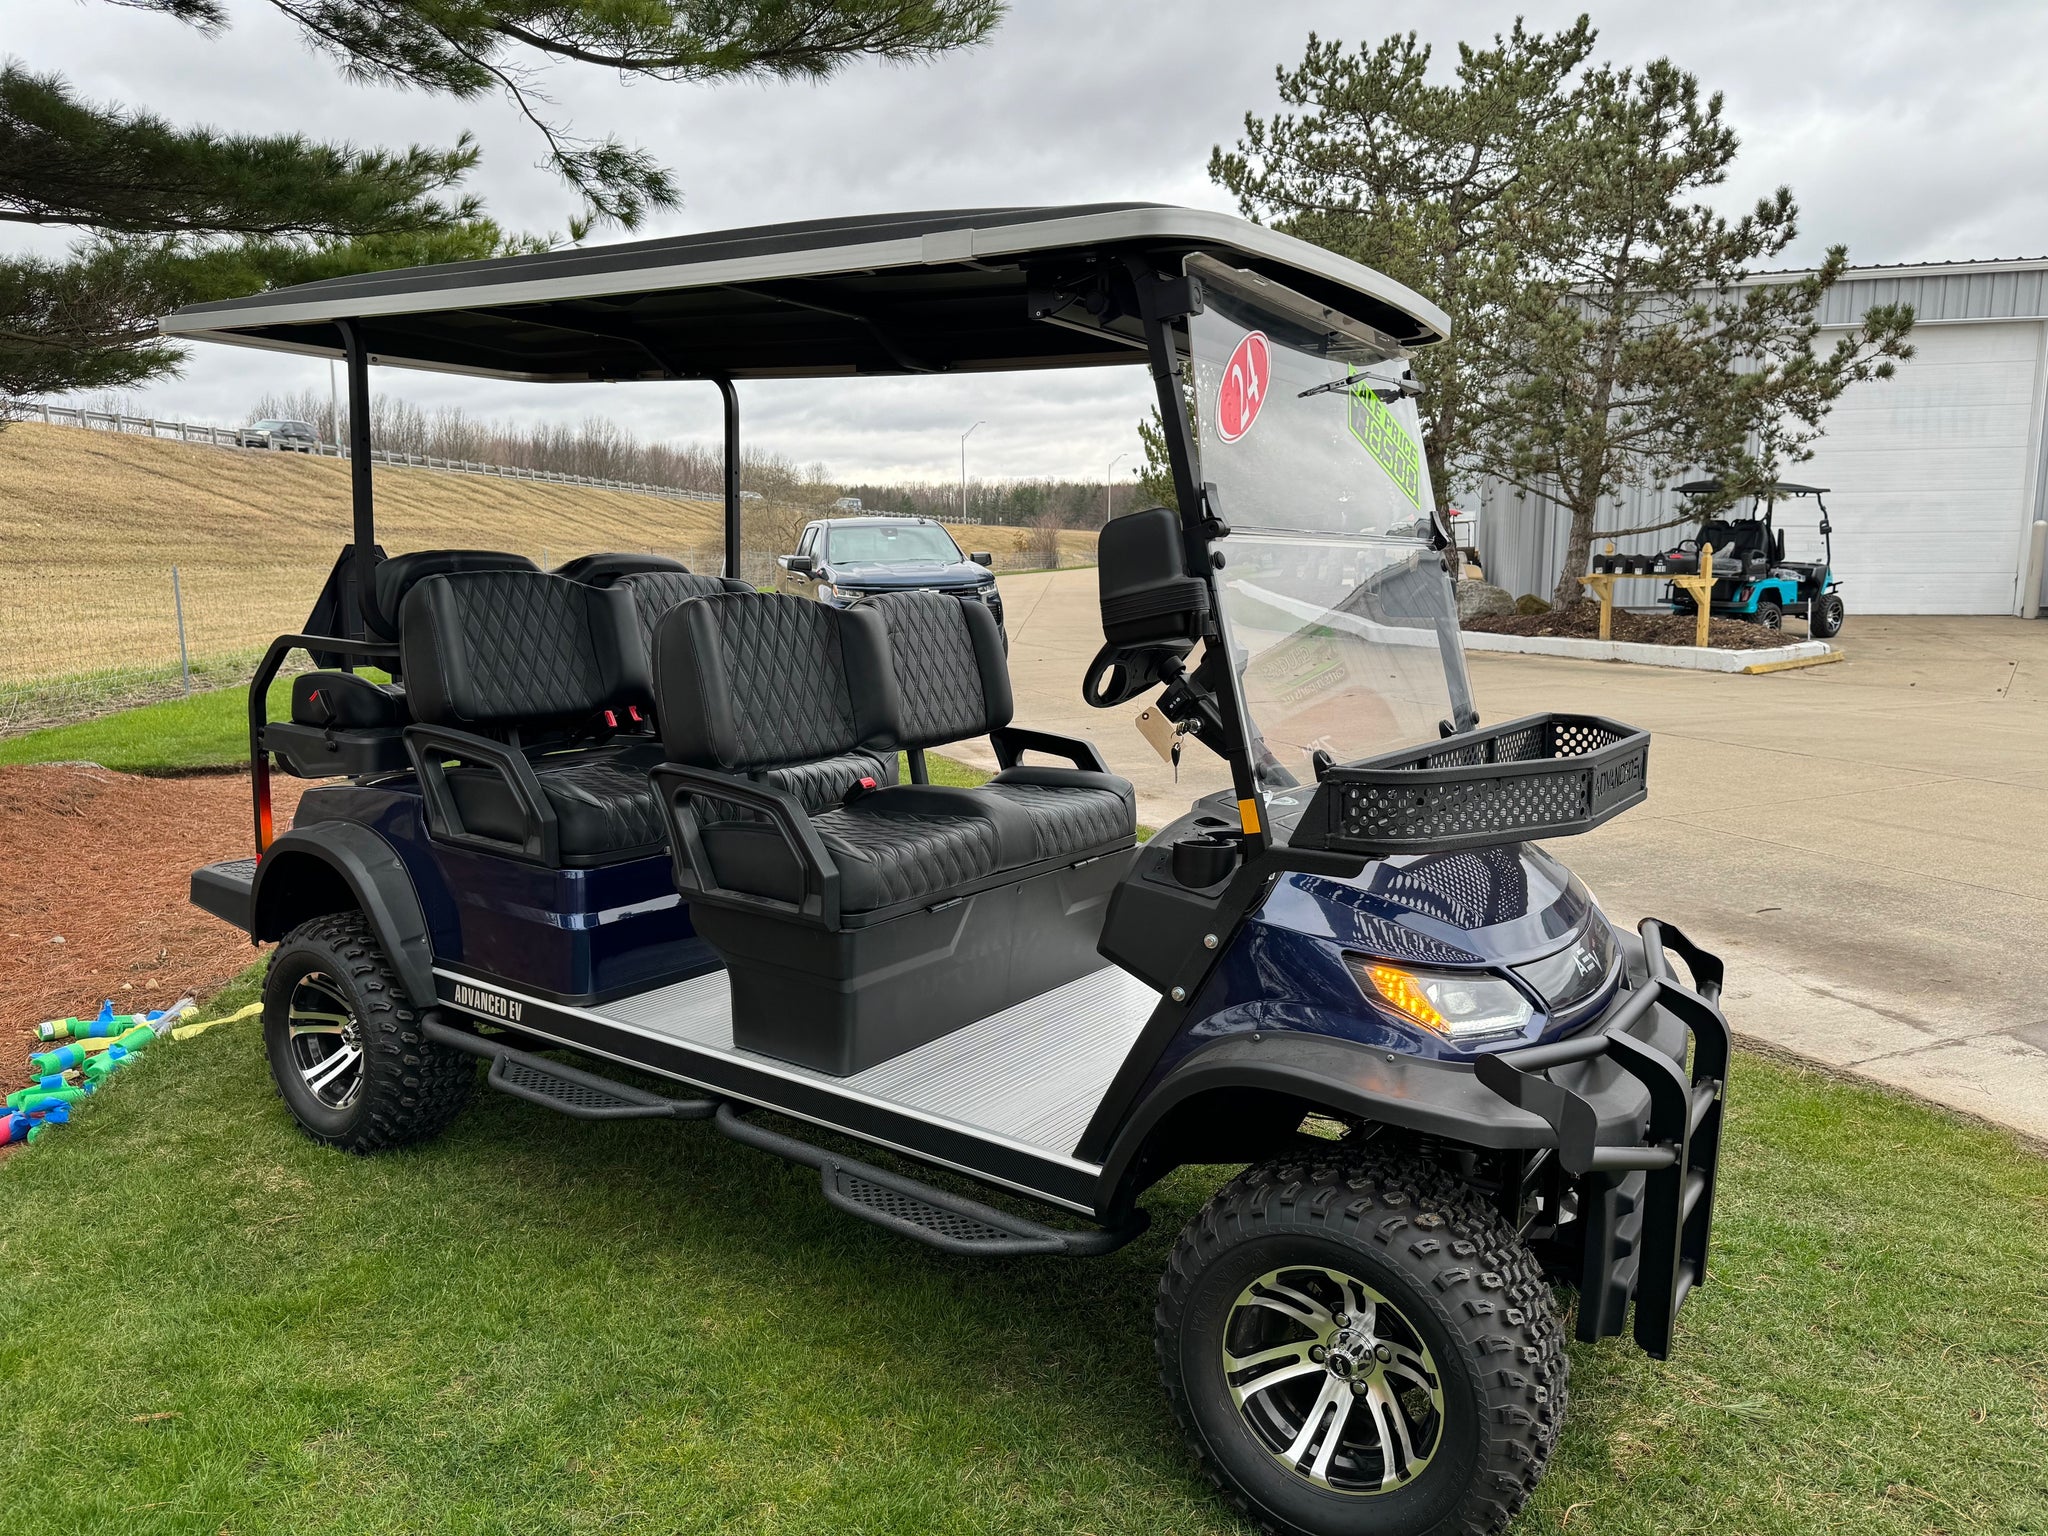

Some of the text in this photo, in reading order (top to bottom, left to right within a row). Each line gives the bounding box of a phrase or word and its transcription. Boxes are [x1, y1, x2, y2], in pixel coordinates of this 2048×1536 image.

[1232, 339, 1260, 432] 24
[1384, 411, 1418, 464] PRICE
[454, 983, 522, 1022] ADVANCED EV
